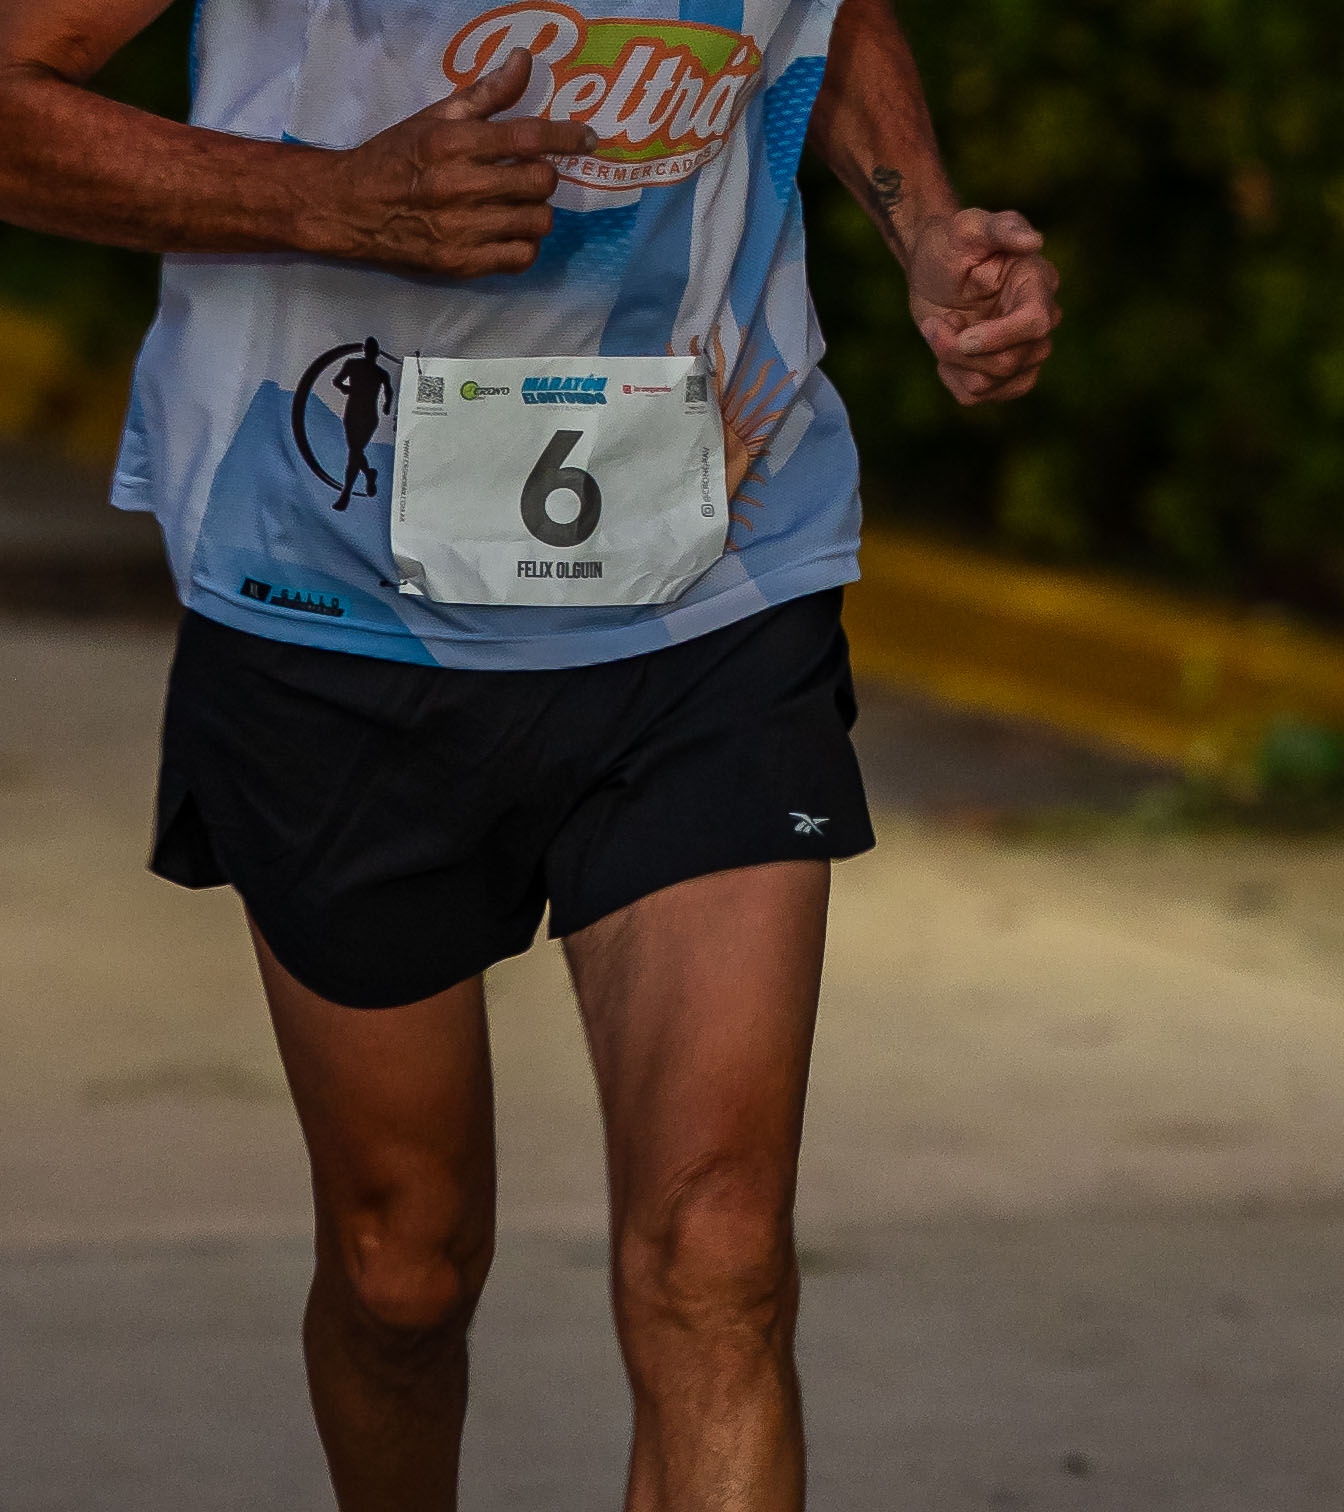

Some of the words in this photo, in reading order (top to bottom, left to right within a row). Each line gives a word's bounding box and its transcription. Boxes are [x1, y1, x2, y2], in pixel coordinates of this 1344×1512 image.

[450, 8, 749, 144] Beltrá
[520, 430, 602, 548] 6
[517, 560, 553, 578] FELIX
[556, 561, 603, 579] OLGUIN
